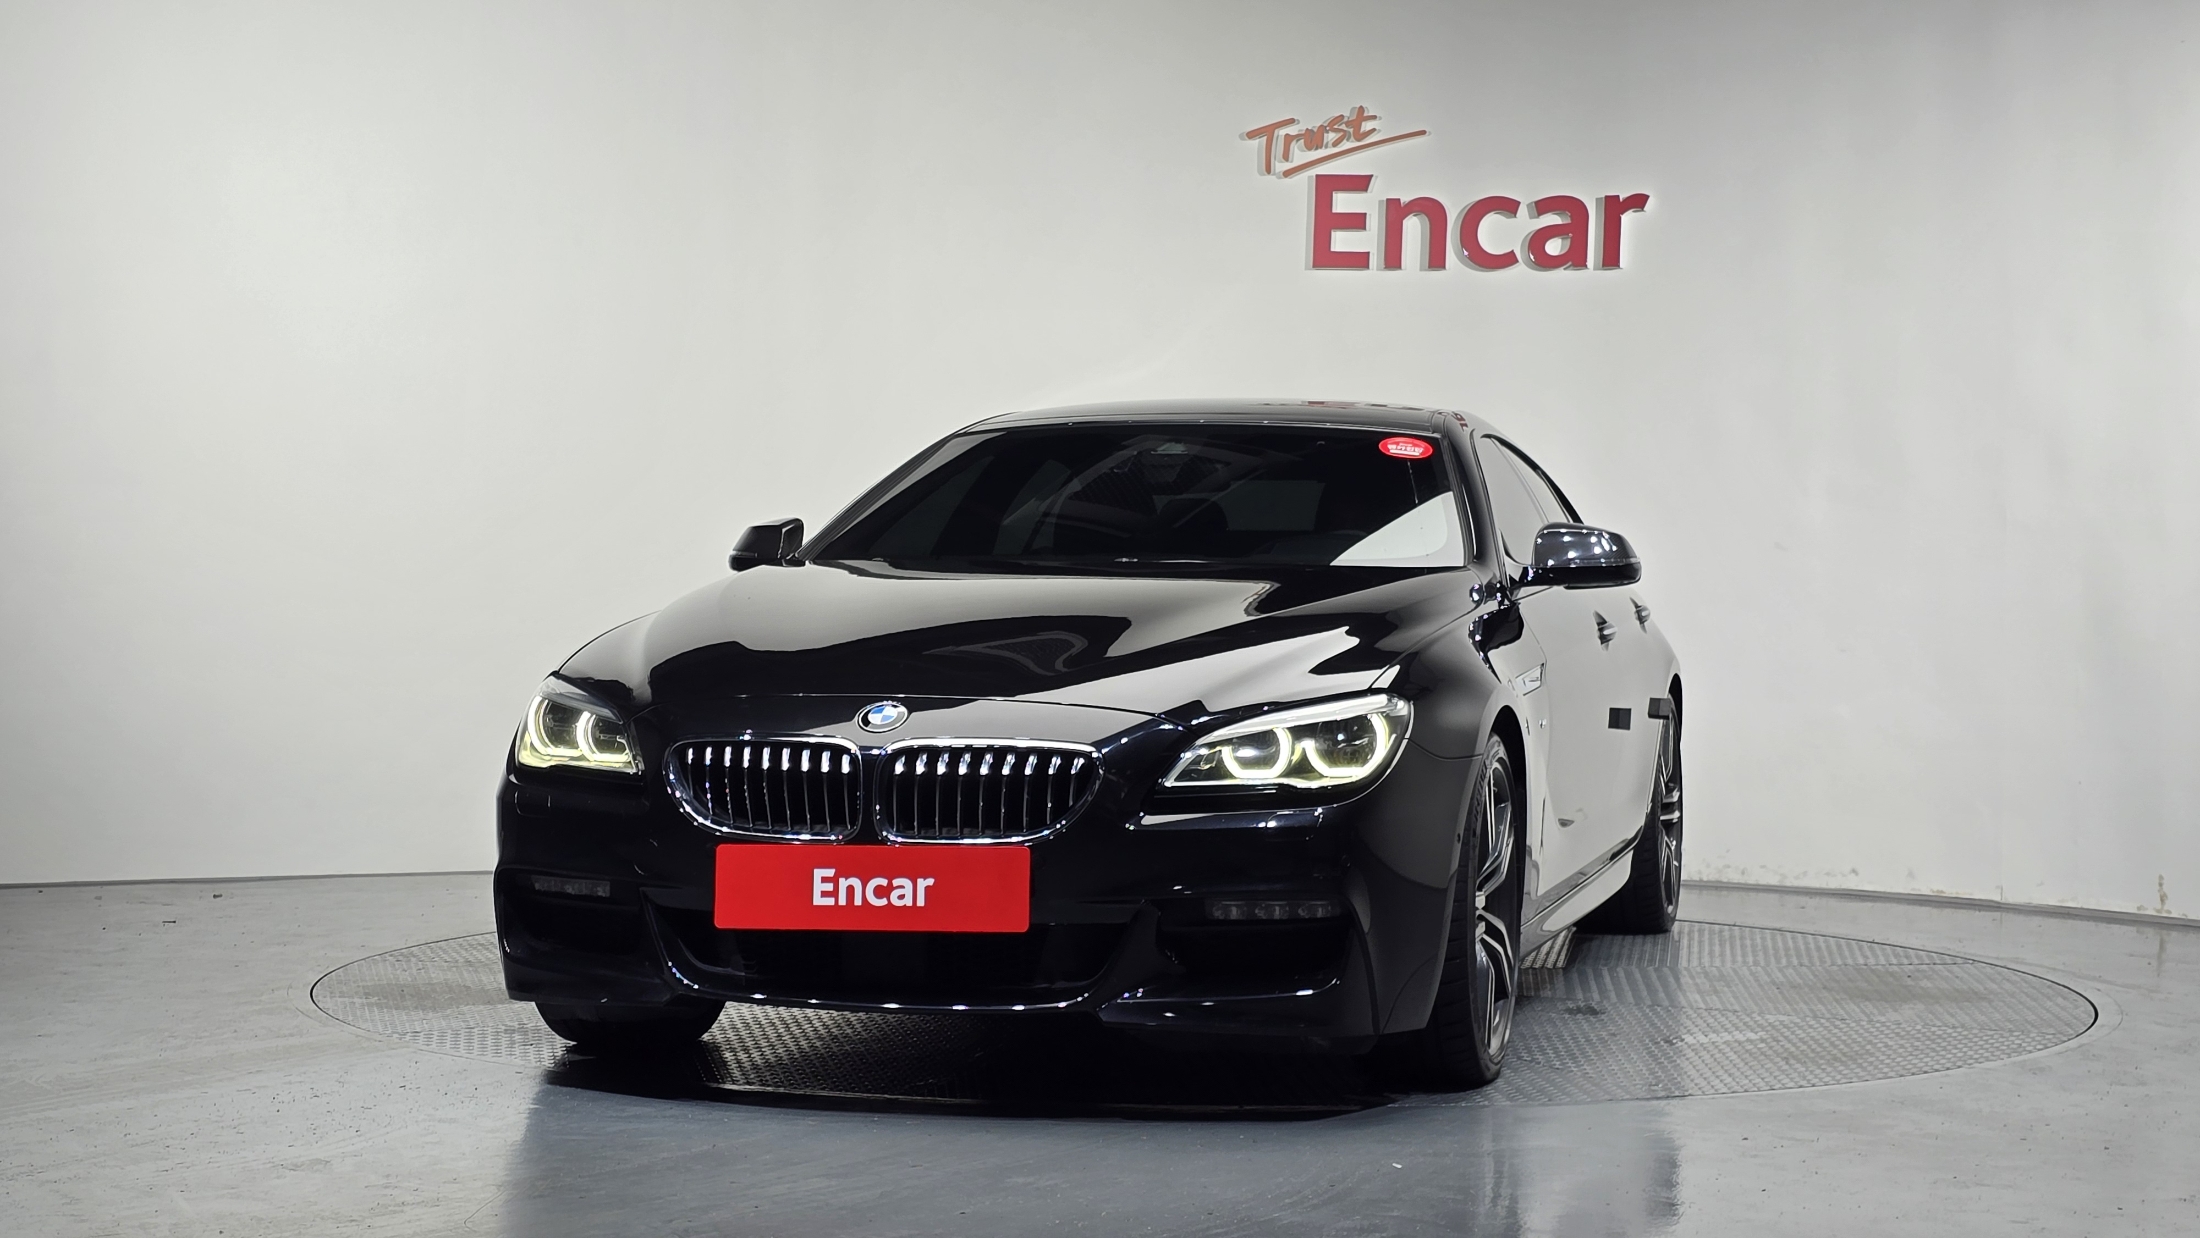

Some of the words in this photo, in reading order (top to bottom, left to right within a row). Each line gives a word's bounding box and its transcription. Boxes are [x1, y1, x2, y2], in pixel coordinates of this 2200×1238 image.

[1245, 105, 1378, 175] Trust
[1311, 173, 1651, 270] Encar
[812, 868, 935, 907] Encar
